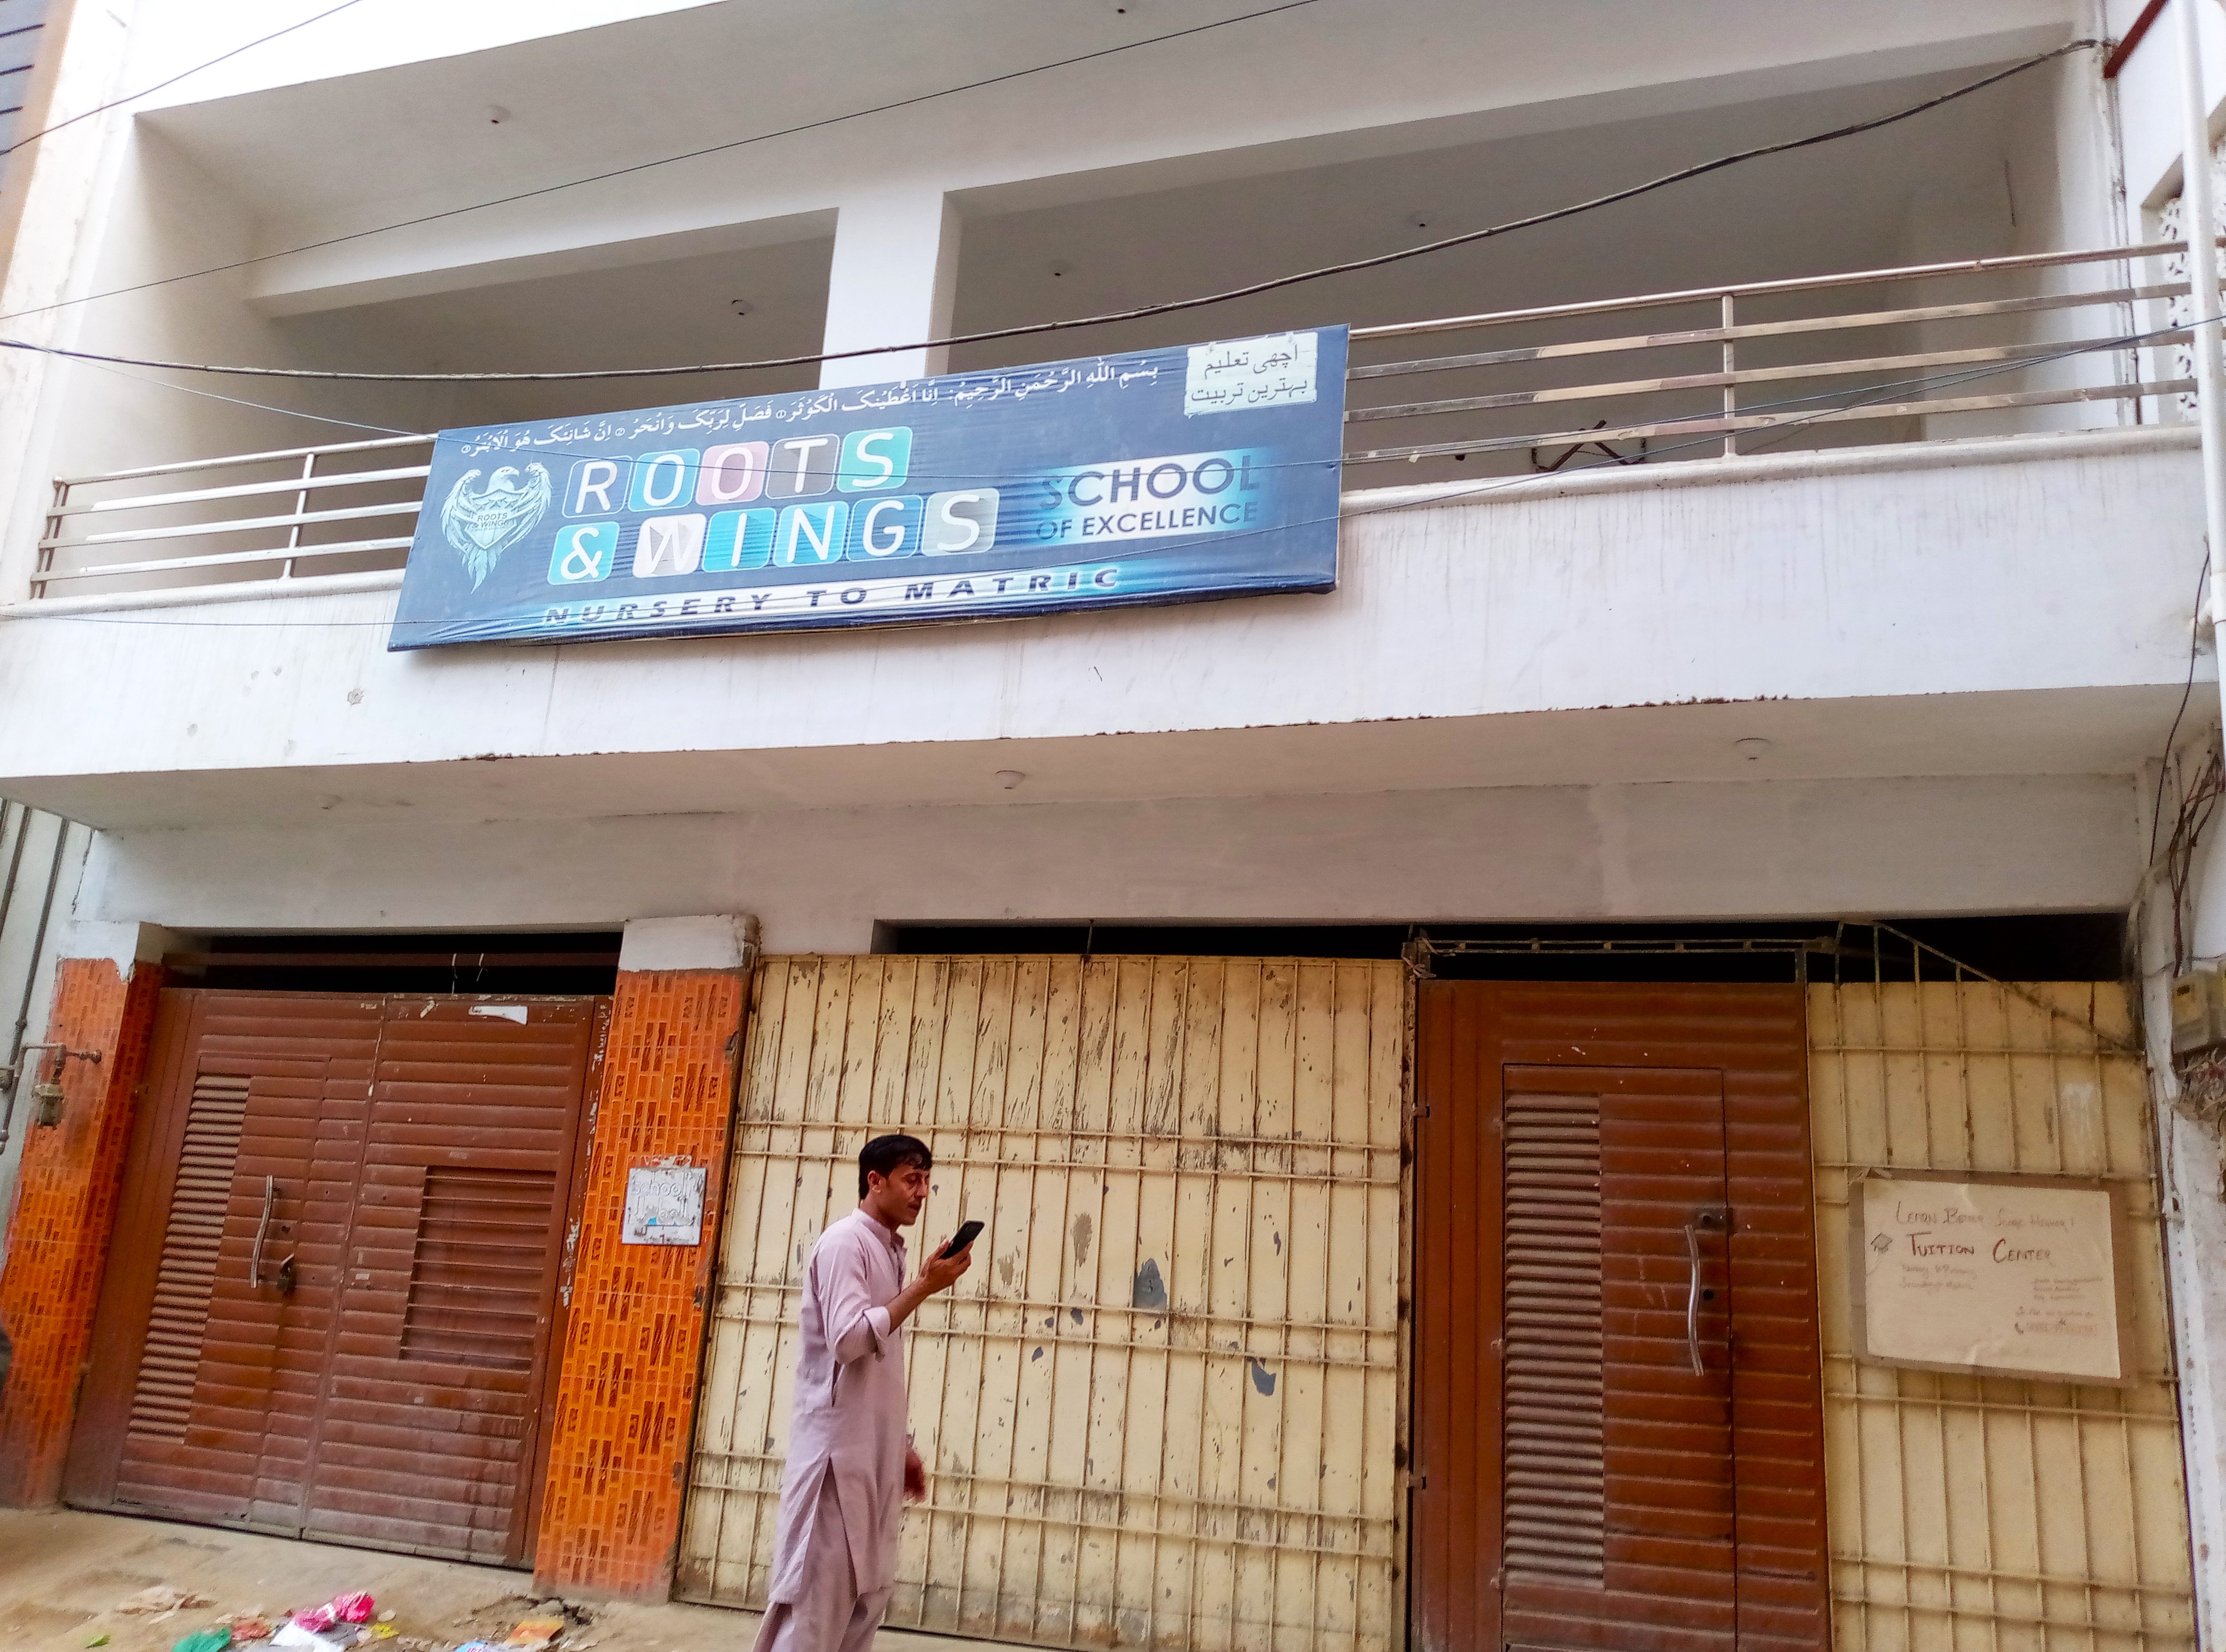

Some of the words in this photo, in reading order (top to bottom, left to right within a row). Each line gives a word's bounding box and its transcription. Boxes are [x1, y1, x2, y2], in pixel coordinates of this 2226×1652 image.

[1205, 350, 1249, 380] تعلیم
[1191, 382, 1245, 406] تربیت
[1247, 377, 1308, 403] بہترین
[575, 432, 894, 514] ROOTS
[1040, 455, 1260, 510] SCHOOL
[477, 512, 508, 522] ROOTS
[1036, 518, 1073, 540] OF
[1081, 501, 1259, 537] EXCELLENCE
[560, 526, 603, 581] &
[642, 494, 981, 573] WINGS
[544, 593, 773, 625] NURSERY
[805, 587, 867, 607] TO
[903, 569, 1118, 601] MATRIC
[1905, 1231, 1975, 1257] TUITION
[1992, 1237, 2055, 1264] CENTER
